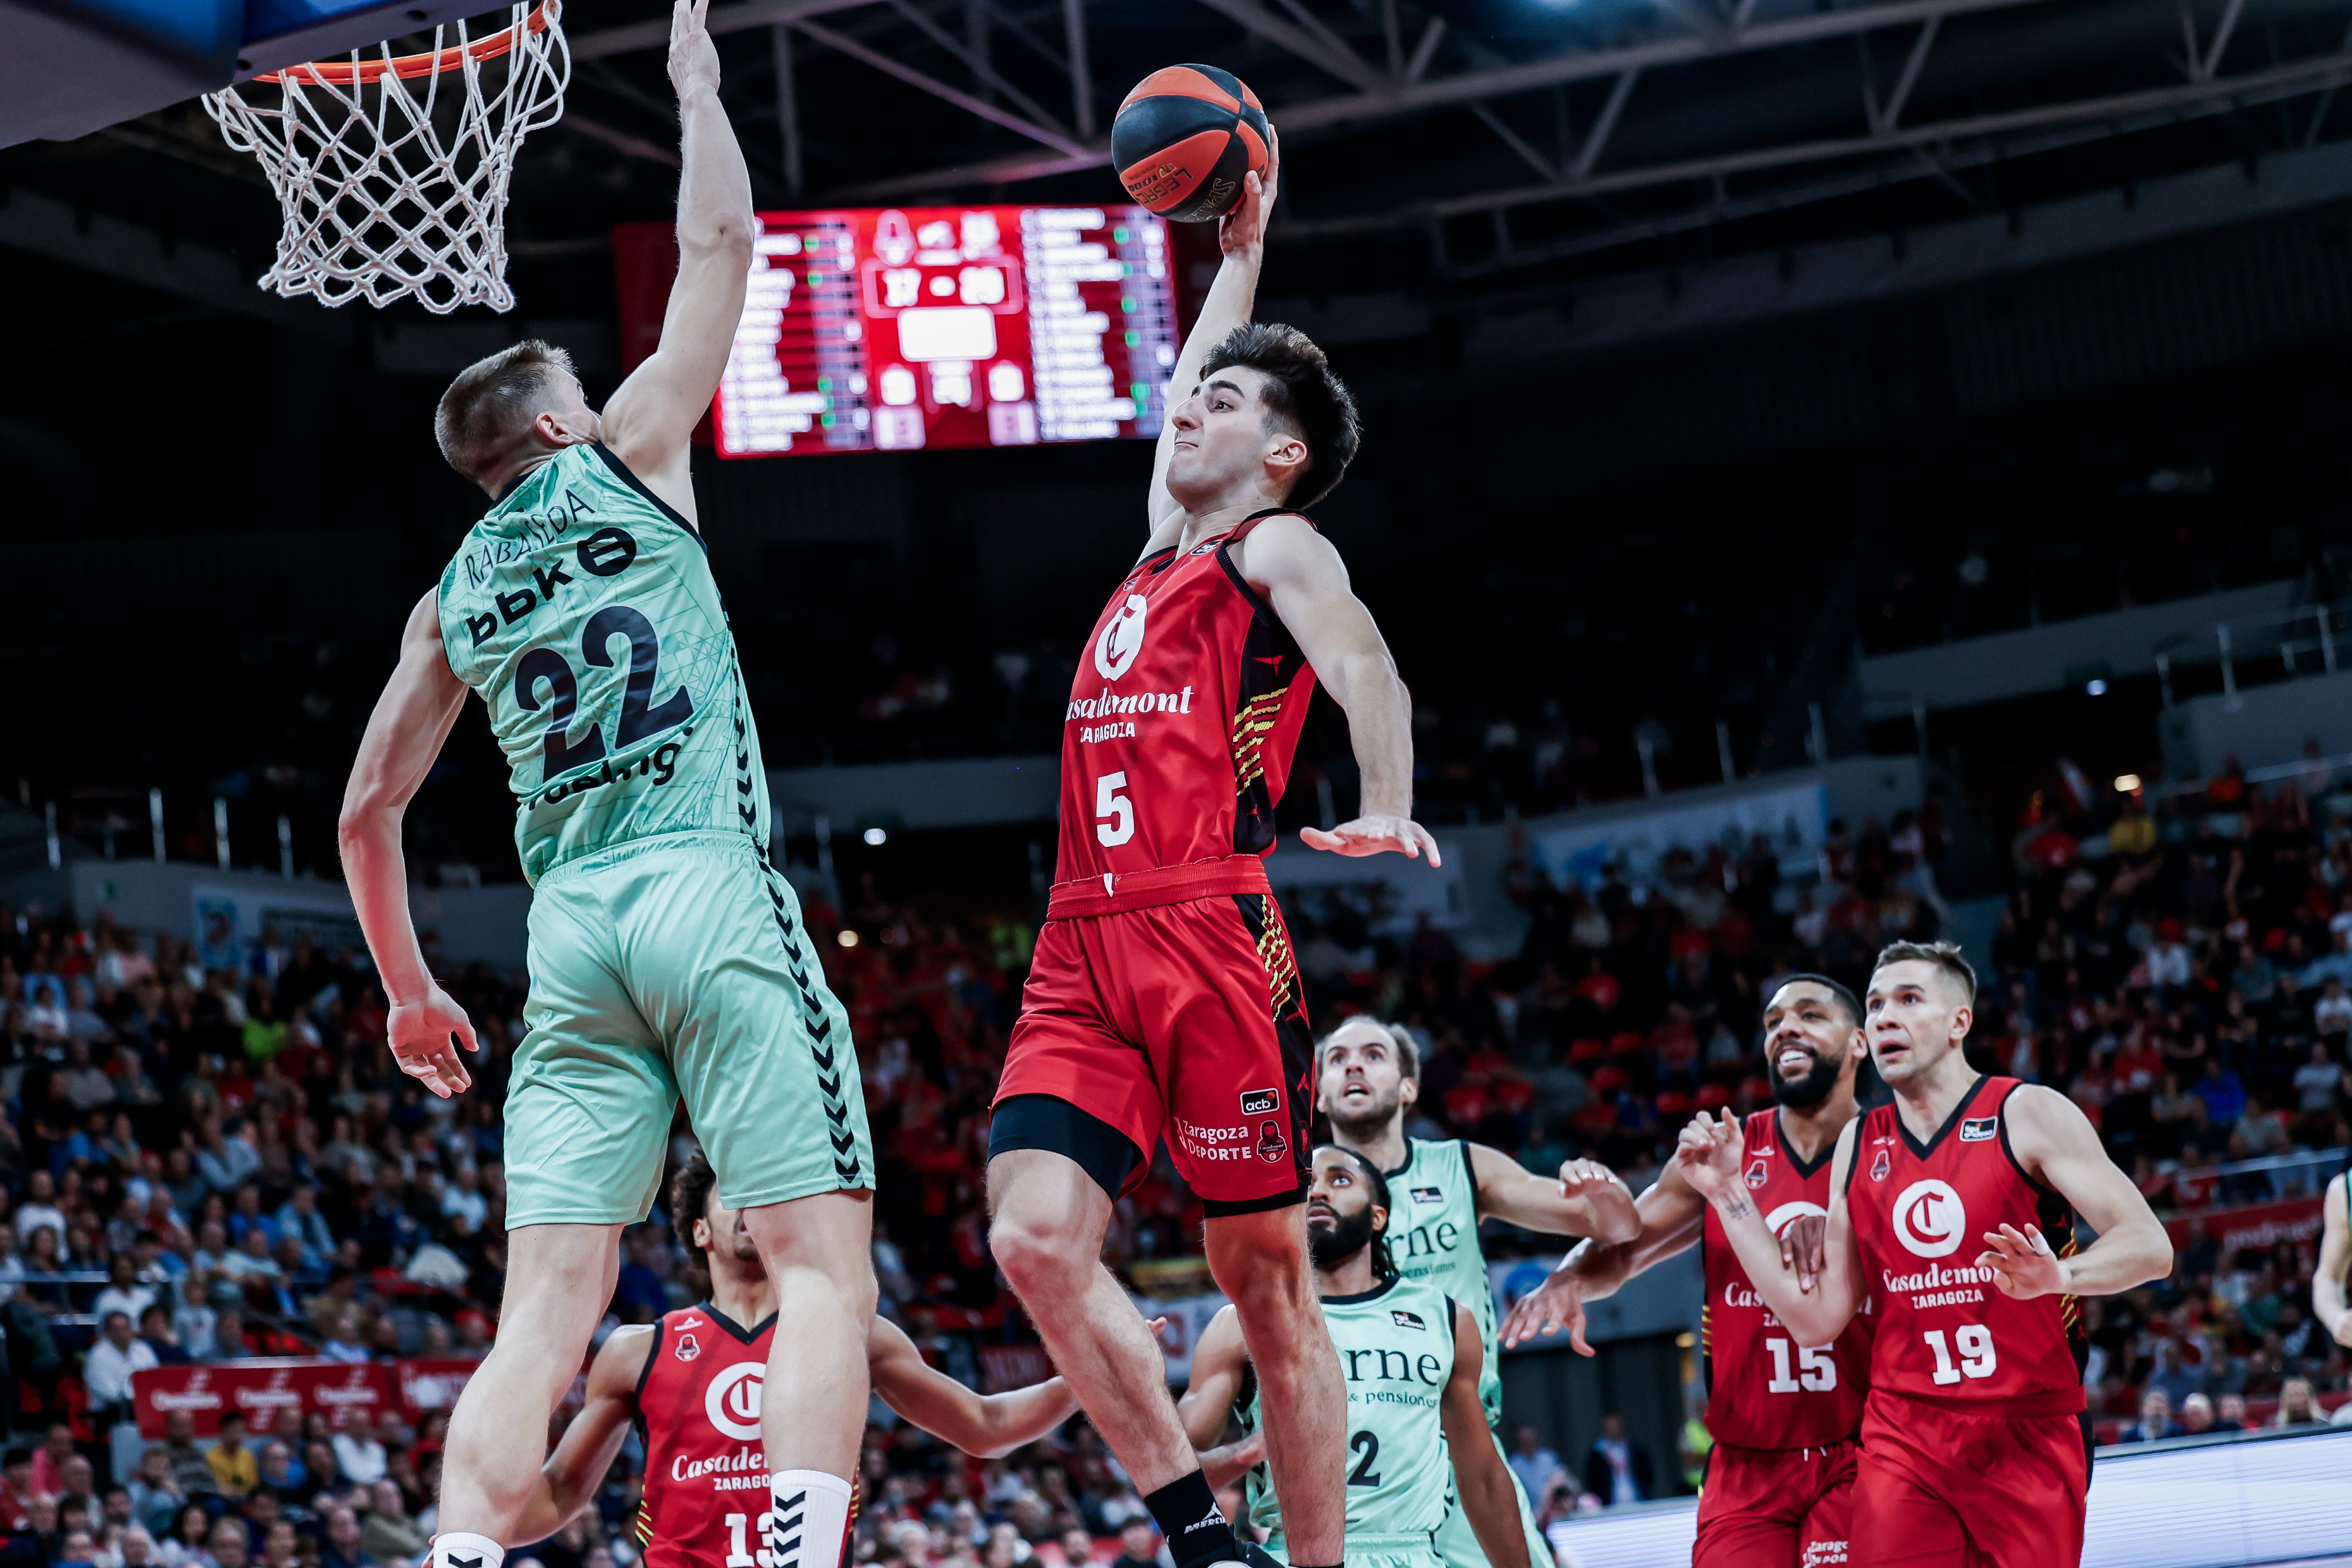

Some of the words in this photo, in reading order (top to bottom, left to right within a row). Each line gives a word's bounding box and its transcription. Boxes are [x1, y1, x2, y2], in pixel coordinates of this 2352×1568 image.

[1133, 167, 1193, 204] LEGAC
[465, 489, 596, 591] RABASEDA
[466, 558, 575, 649] bbk
[514, 605, 695, 783] 22
[1065, 685, 1194, 722] asademont
[1096, 771, 1136, 848] 5
[1245, 1099, 1271, 1112] acb
[1182, 1120, 1249, 1144] Zaragoza
[1384, 1222, 1457, 1264] rne
[1883, 1262, 2001, 1293] Casademo
[1912, 1289, 1984, 1310] ZARAGOZA
[1346, 1348, 1441, 1387] rne
[1765, 1338, 1838, 1393] 15
[1924, 1324, 1997, 1385] 19
[671, 1446, 770, 1482] Casade
[1347, 1431, 1381, 1486] 2
[713, 1477, 770, 1491] ZARAGO
[725, 1511, 773, 1568] 13
